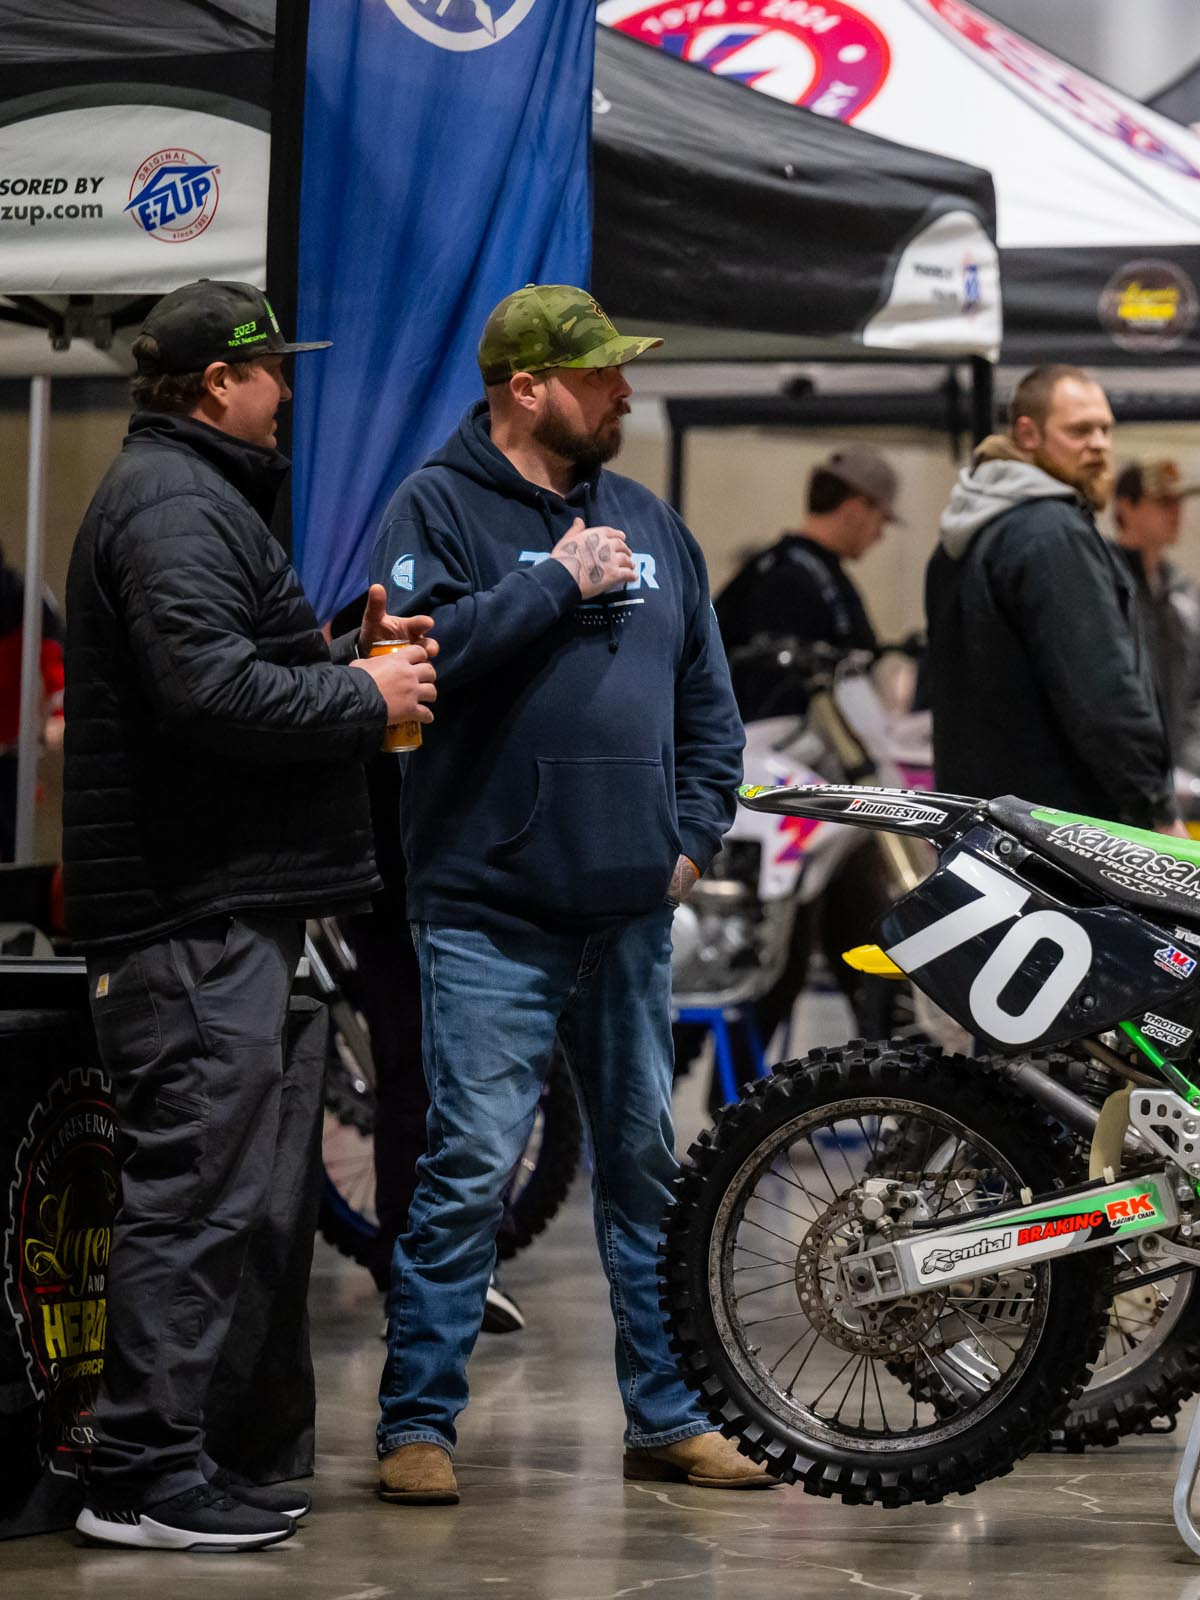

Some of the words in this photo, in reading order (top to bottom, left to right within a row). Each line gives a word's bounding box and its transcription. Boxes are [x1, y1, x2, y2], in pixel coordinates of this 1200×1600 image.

[137, 151, 187, 182] ORIGINAL
[74, 176, 104, 194] BY
[233, 320, 257, 339] 2023
[849, 799, 948, 824] BRIDGESTONE
[1045, 834, 1092, 859] TEAM
[1093, 856, 1131, 875] PRO
[885, 850, 1093, 1045] 70
[1158, 947, 1196, 973] AMA
[1167, 957, 1190, 977] RACING
[1142, 1025, 1184, 1046] JOCKEY
[1144, 1013, 1191, 1037] THROTTLE
[57, 1113, 119, 1149] PRESERVA
[1106, 1194, 1155, 1221] RK
[1111, 1215, 1137, 1227] RACING
[1137, 1209, 1157, 1220] CHAIN
[1017, 1210, 1103, 1246] BRAKING
[921, 1233, 1011, 1275] Renthal
[87, 1273, 105, 1293] AND
